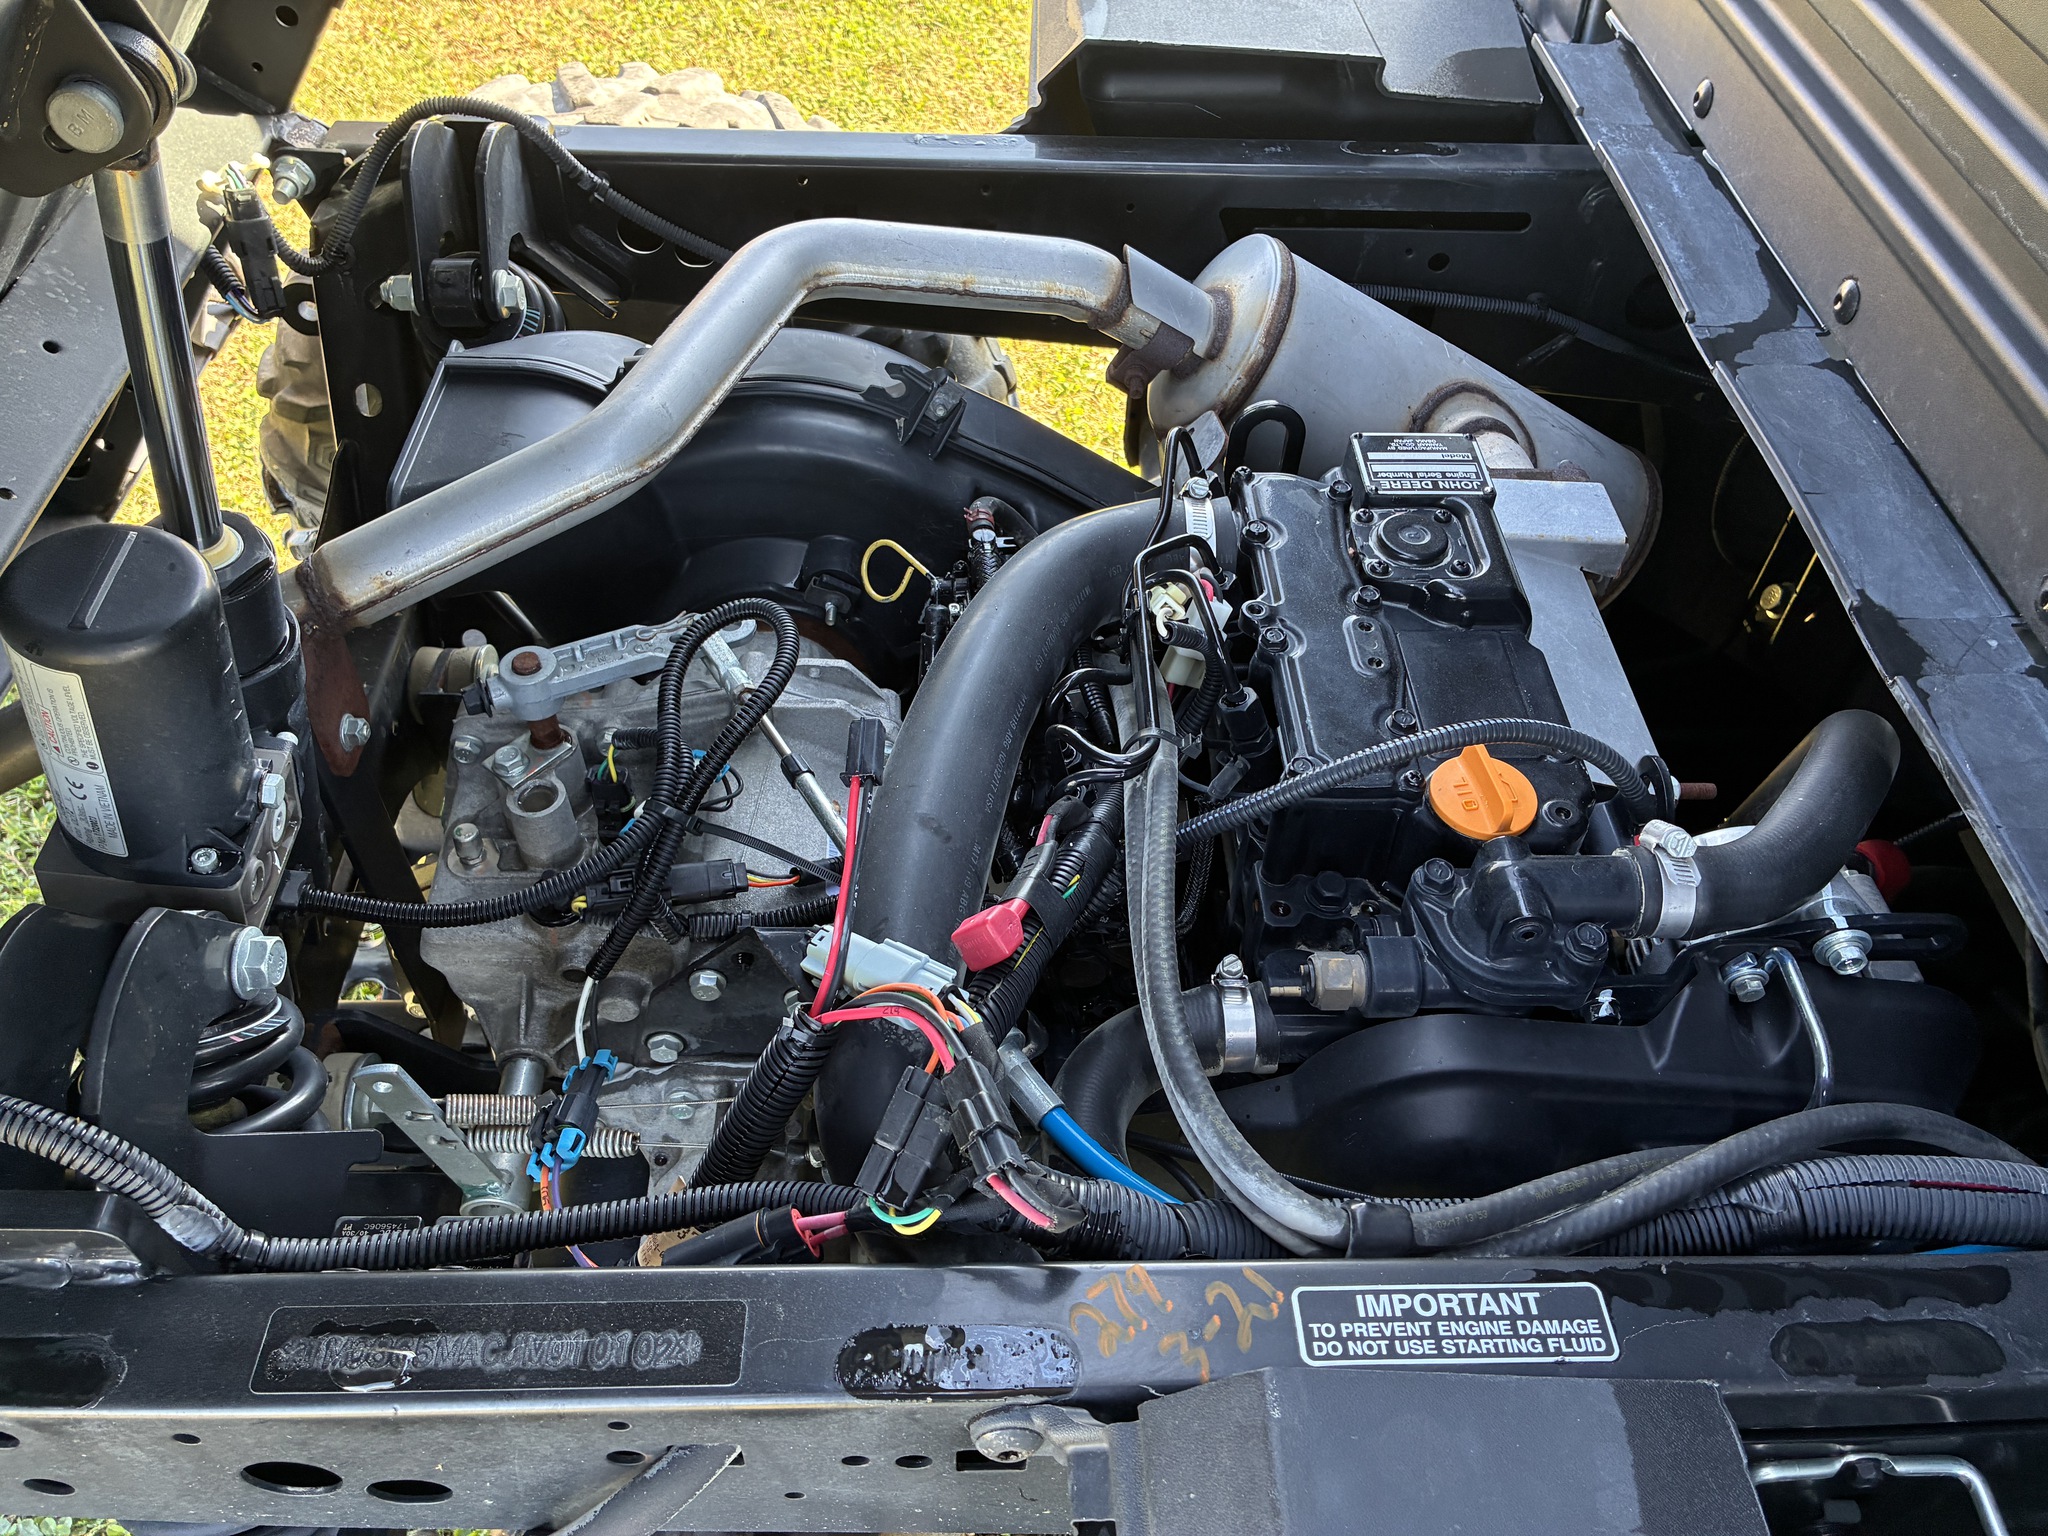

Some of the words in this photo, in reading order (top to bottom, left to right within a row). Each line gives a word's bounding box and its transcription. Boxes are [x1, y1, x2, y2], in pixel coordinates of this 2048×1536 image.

[1380, 480, 1433, 488] DEERE
[1438, 480, 1480, 489] JOHN
[41, 709, 57, 744] CAUTION
[94, 784, 112, 812] VIETNAM
[984, 792, 994, 813] USA
[1454, 777, 1479, 812] OIL
[104, 820, 118, 838] MADE
[958, 890, 969, 914] ABG
[1355, 1292, 1540, 1317] IMPORTANT
[1309, 1323, 1336, 1338] TO
[1342, 1322, 1432, 1337] PREVENT
[1439, 1320, 1511, 1336] ENGINE
[1518, 1319, 1602, 1335] DAMAGE
[1312, 1341, 1342, 1356] DO
[1349, 1340, 1390, 1356] NOT
[1396, 1339, 1435, 1355] USE
[1443, 1338, 1540, 1354] STARTING
[1546, 1337, 1606, 1352] FLUID
